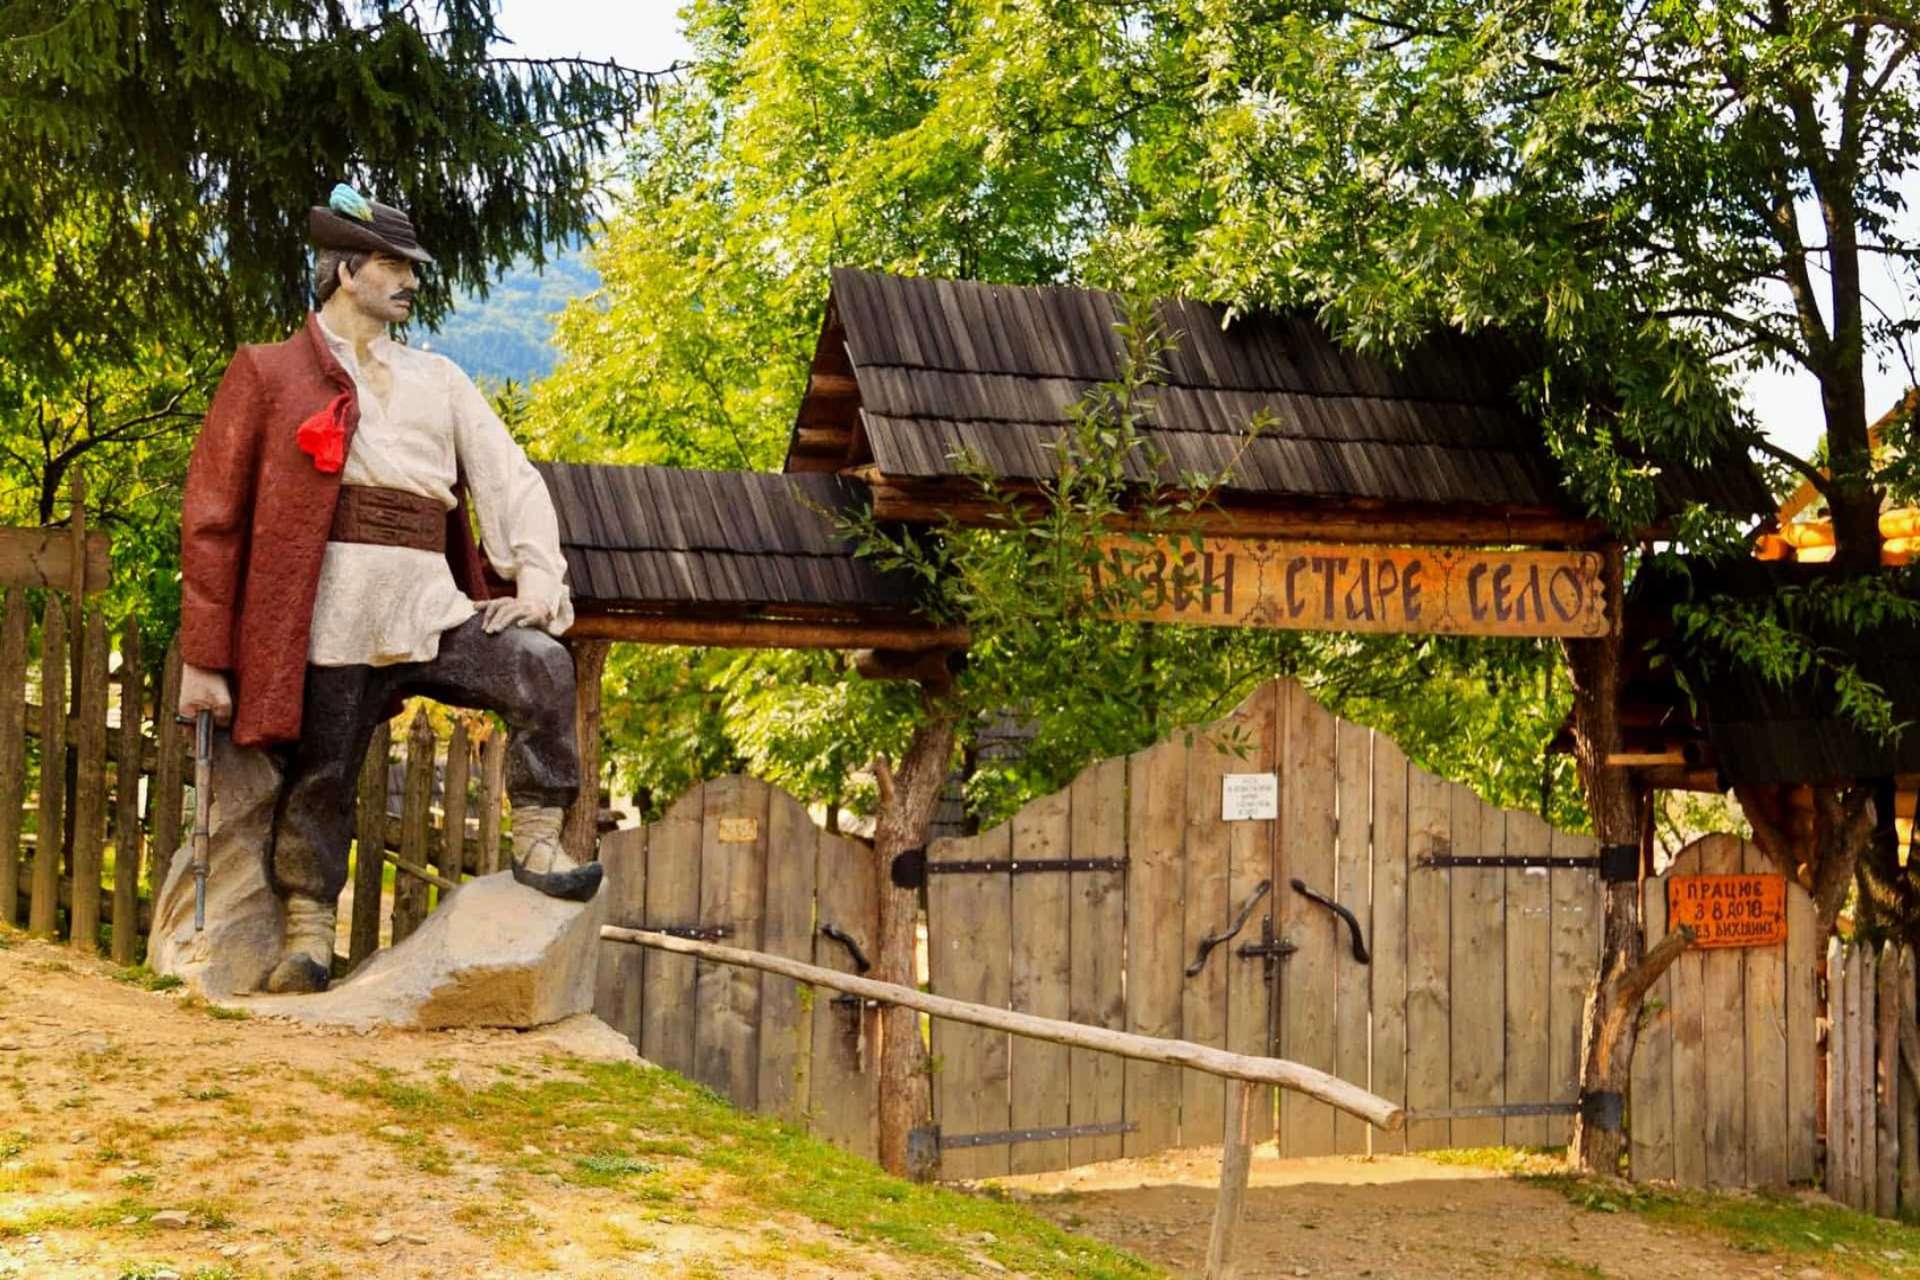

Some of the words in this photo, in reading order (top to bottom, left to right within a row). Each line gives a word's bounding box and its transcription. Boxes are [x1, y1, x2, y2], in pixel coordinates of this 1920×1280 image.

[1286, 556, 1422, 621] СТАРЕ
[1468, 562, 1583, 622] СЕЛО
[1688, 881, 1764, 899] ПРАЦЮЄ
[1712, 900, 1723, 920] 8
[1688, 923, 1710, 938] ЕЗ
